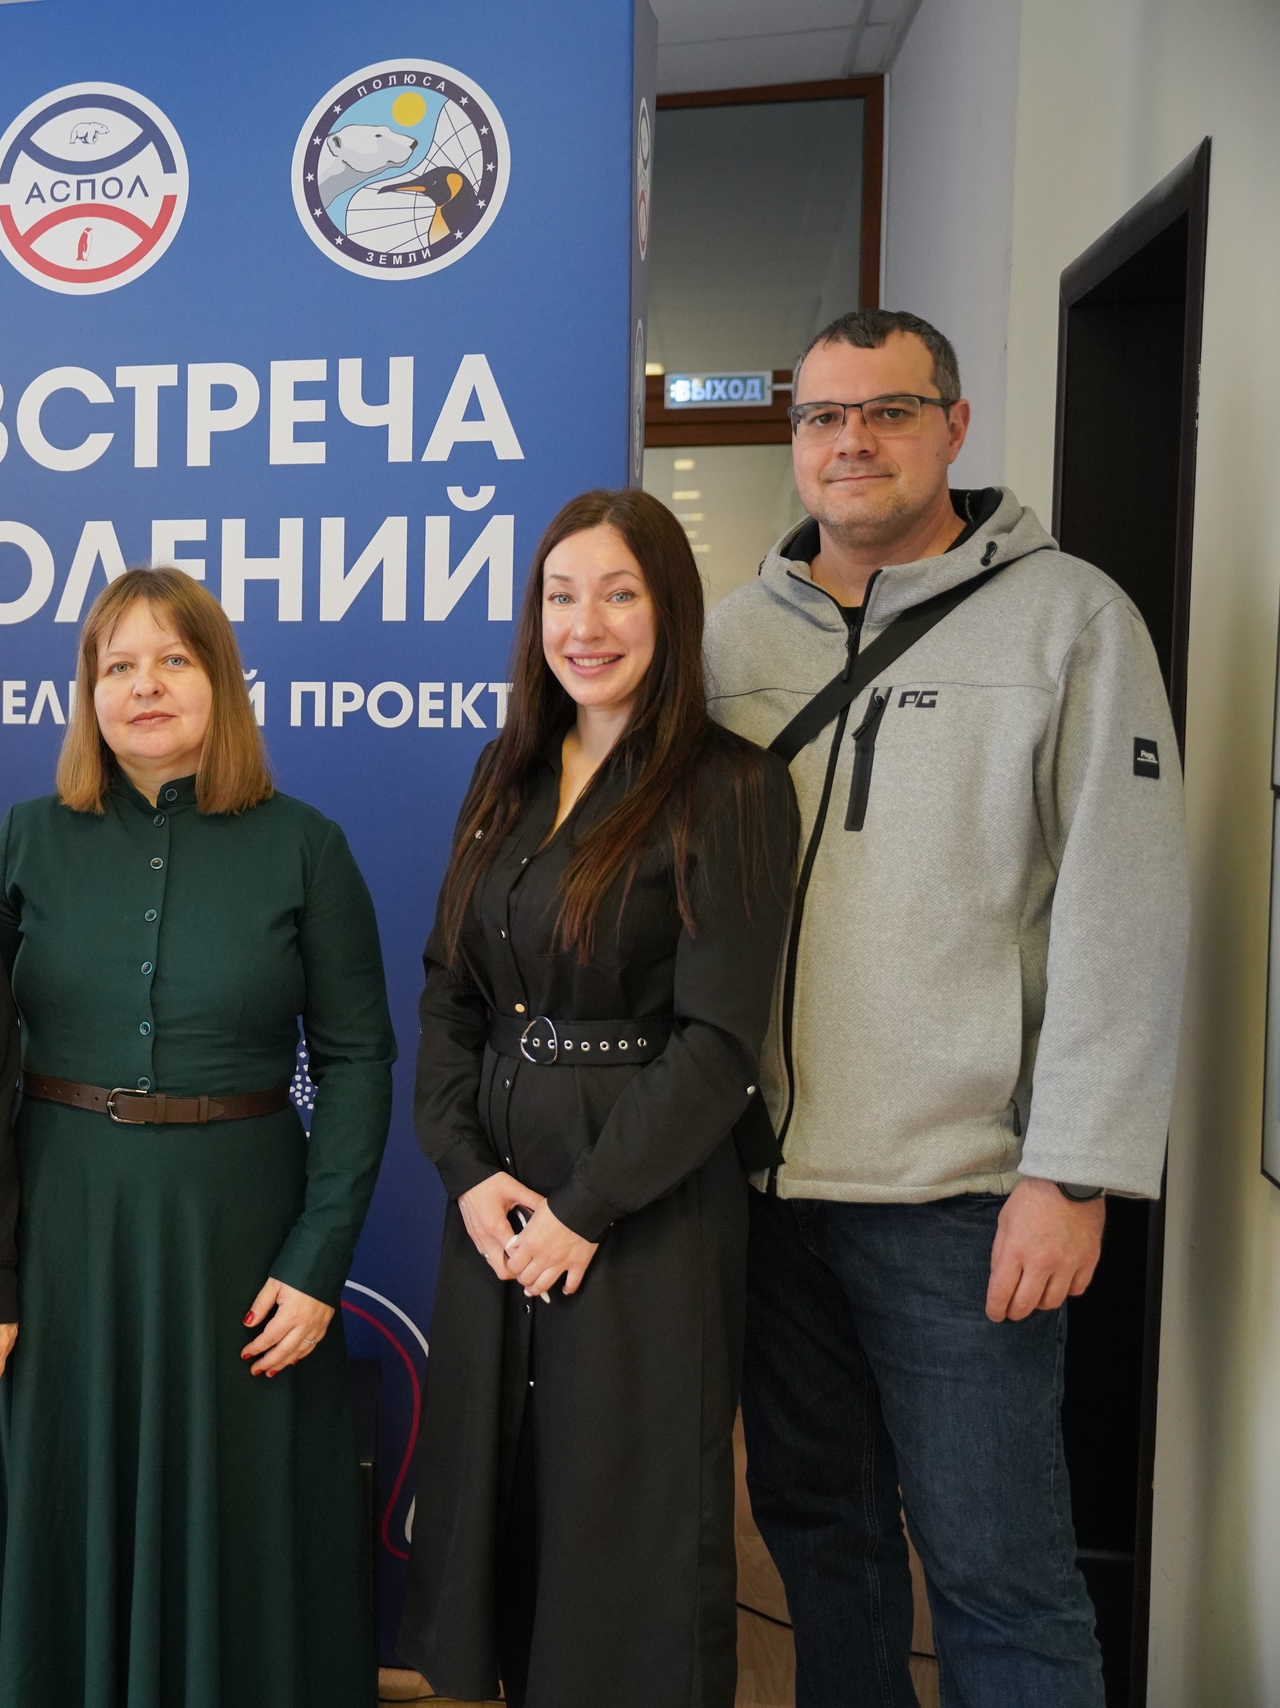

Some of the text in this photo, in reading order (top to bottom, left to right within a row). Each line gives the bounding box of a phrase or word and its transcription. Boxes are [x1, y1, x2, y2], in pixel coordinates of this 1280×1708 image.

[357, 74, 446, 97] ПОЛЮСА
[24, 175, 149, 205] АСПОЛ
[365, 248, 431, 265] ЗЕМЛИ
[675, 378, 762, 402] ВЫХОД
[290, 681, 514, 728] ПРОЕКТ
